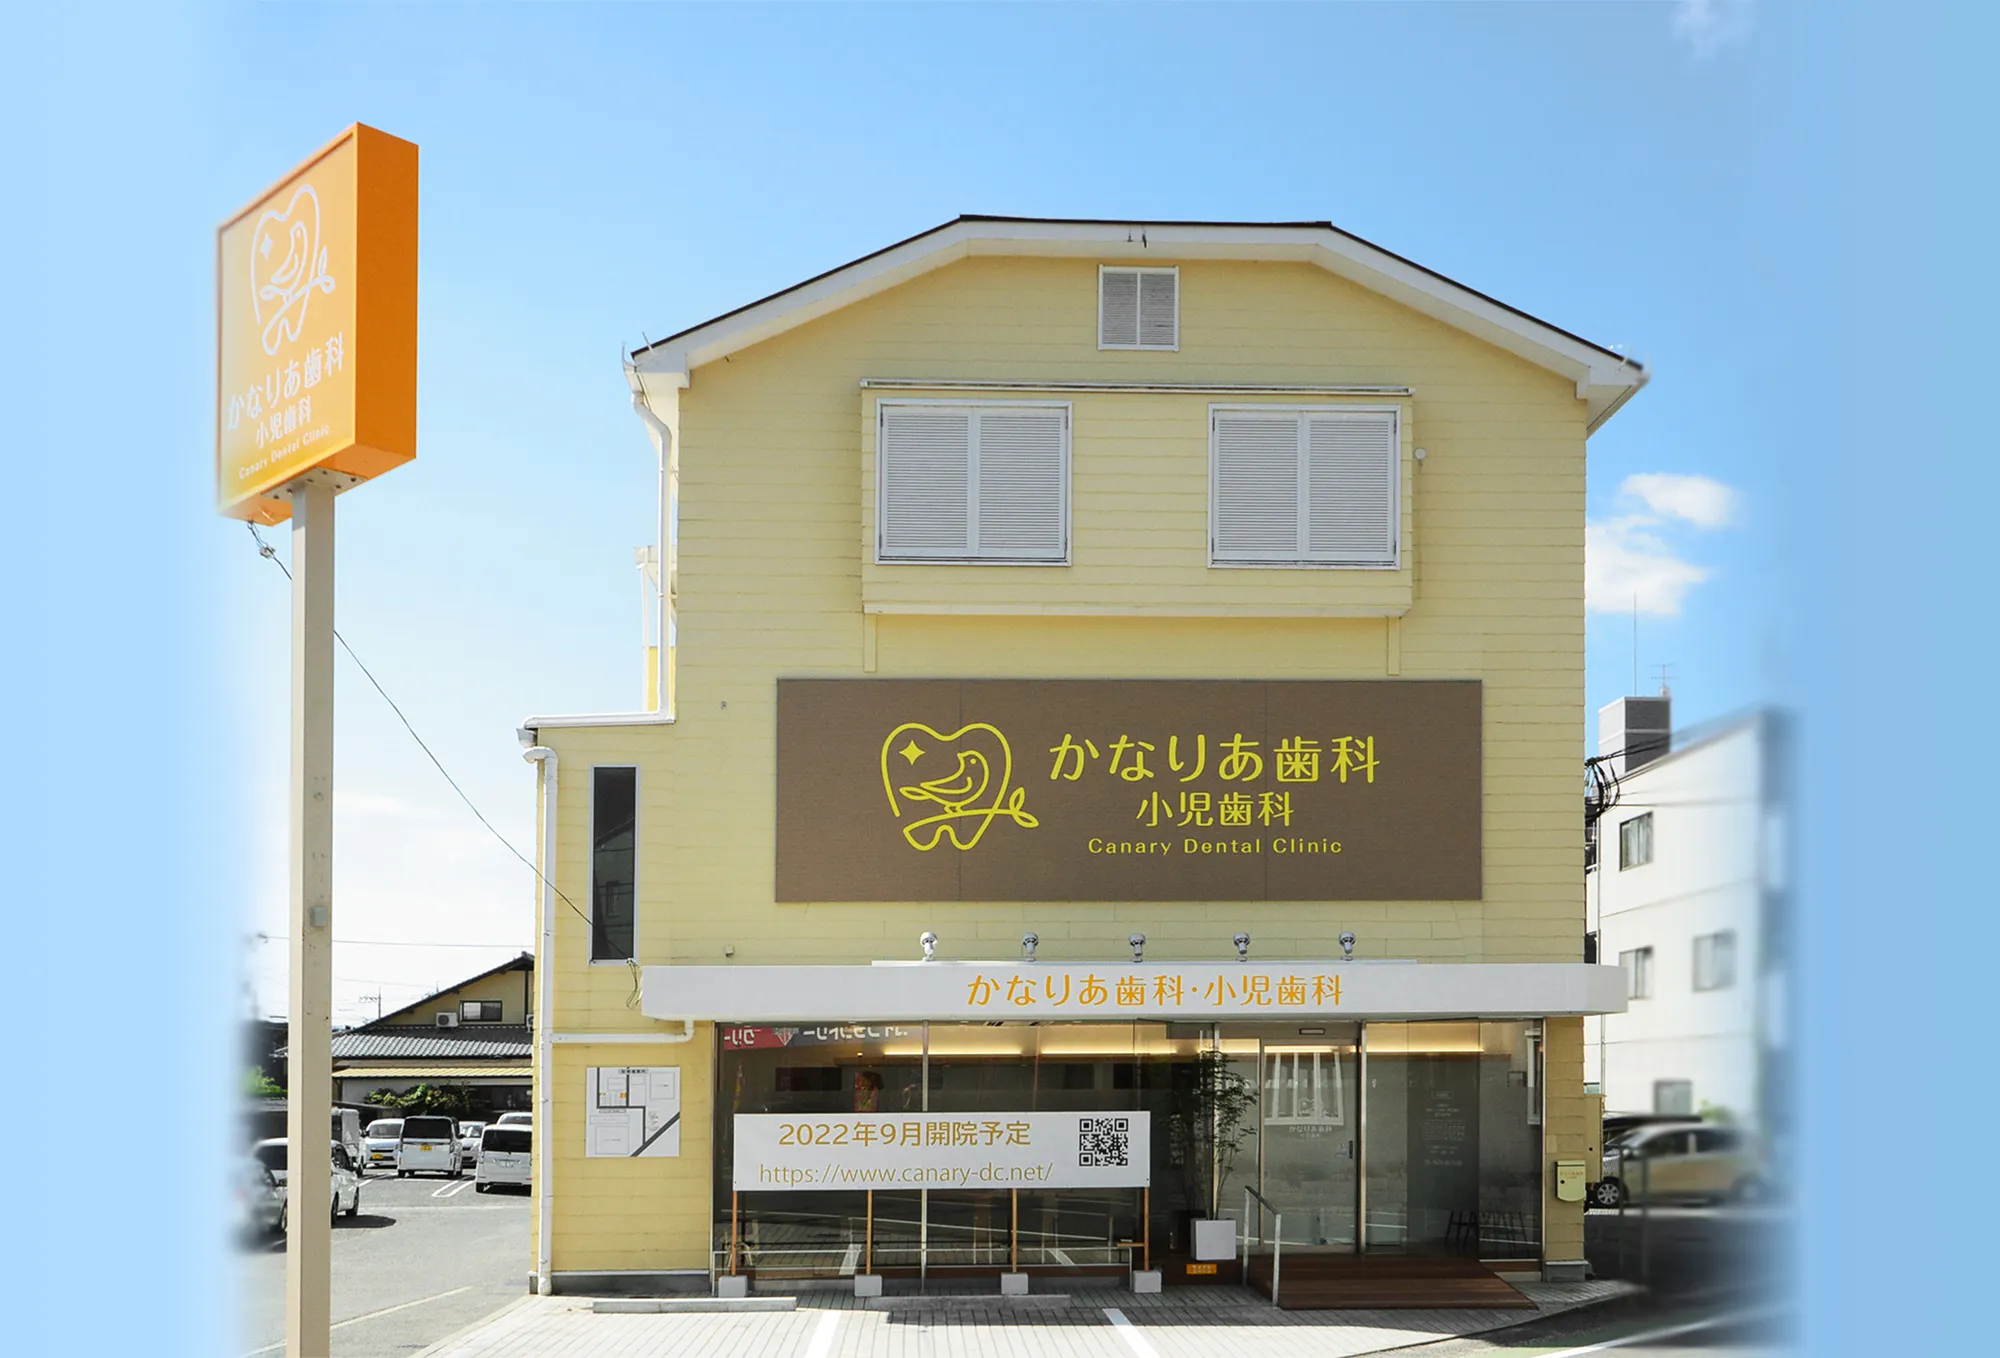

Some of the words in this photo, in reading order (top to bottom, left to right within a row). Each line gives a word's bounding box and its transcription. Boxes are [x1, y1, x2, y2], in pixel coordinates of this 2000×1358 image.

[226, 331, 344, 432] かなりあ歯科
[255, 394, 312, 449] 小児歯科
[239, 457, 269, 480] Canary
[271, 438, 300, 463] Dental
[303, 424, 331, 446] Clinic
[1049, 733, 1380, 783] かなりあ歯科
[1136, 791, 1295, 827] 小児歯科
[1088, 838, 1172, 855] Canary
[1184, 838, 1261, 853] Dental
[1273, 838, 1342, 853] Clinic
[967, 973, 1343, 1007] かなりあ歯科・小児歯科
[779, 1121, 1031, 1147] 2022年9月開院予定
[760, 1162, 1054, 1188] https://www.canary-dc.net/
